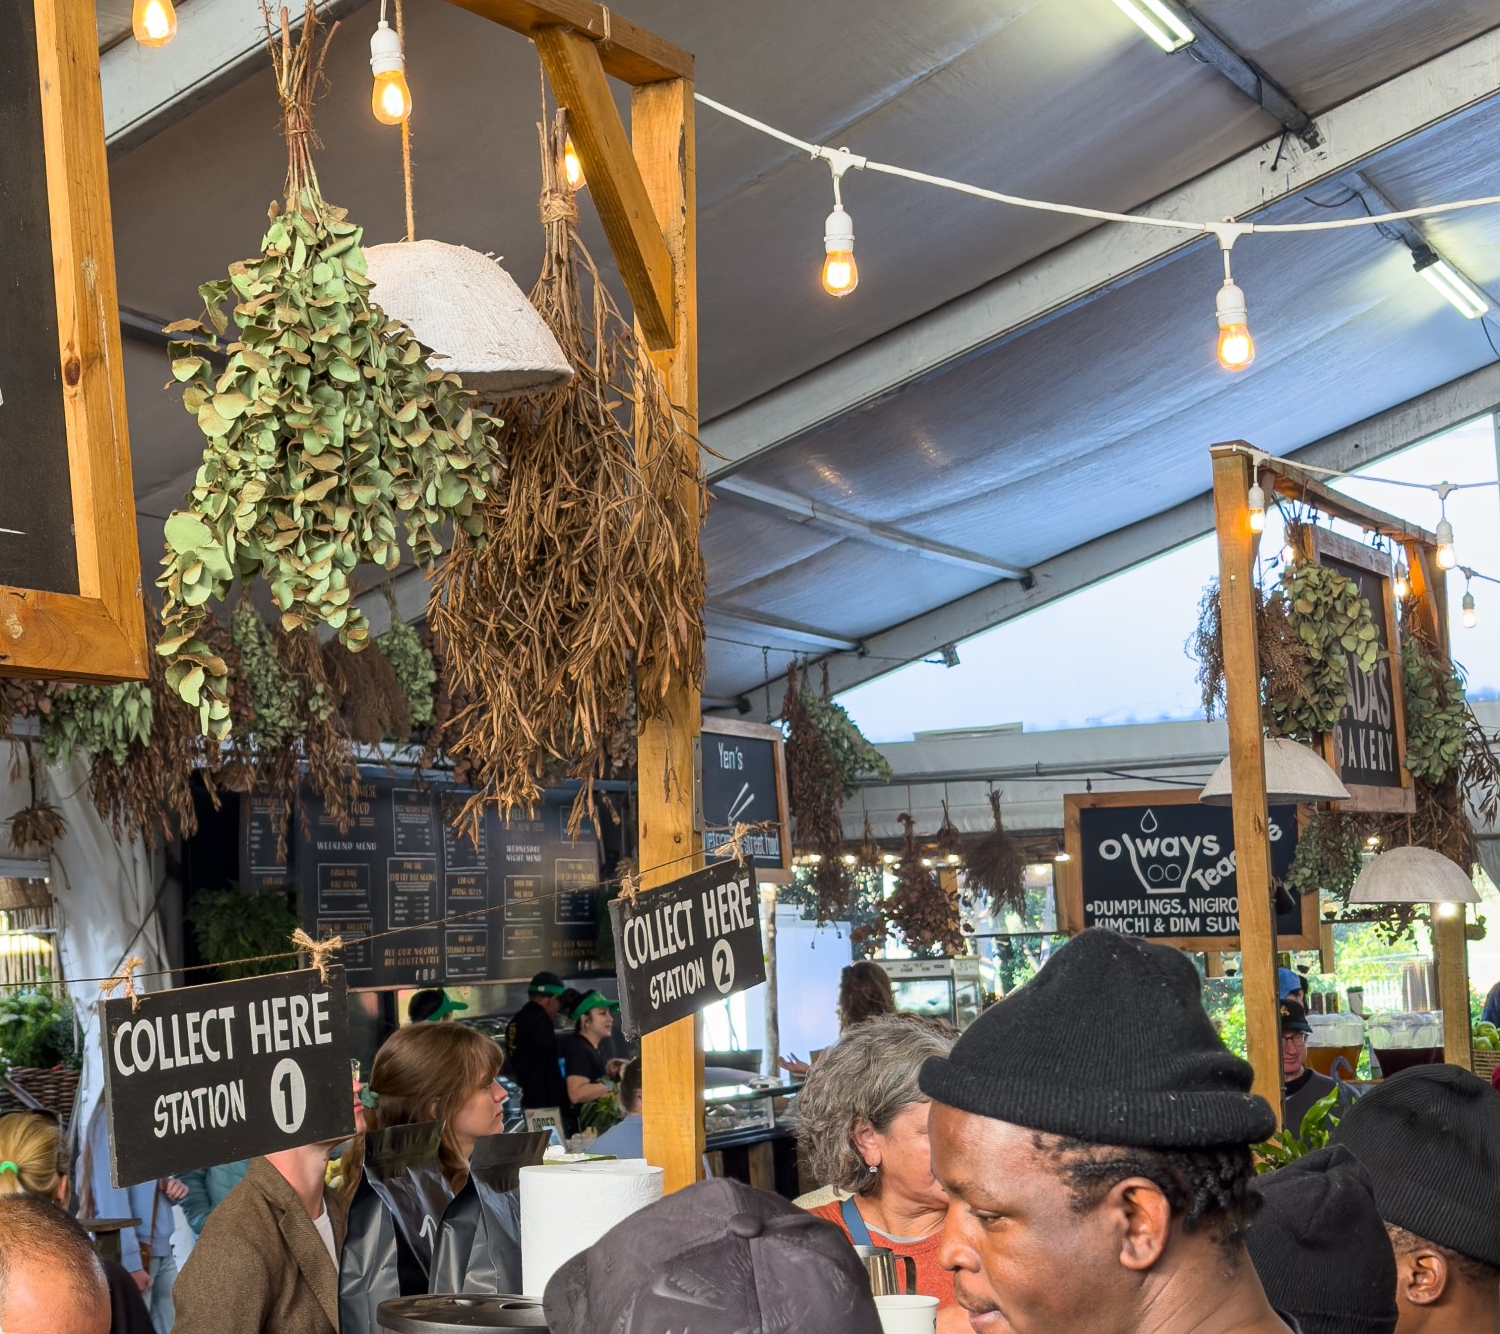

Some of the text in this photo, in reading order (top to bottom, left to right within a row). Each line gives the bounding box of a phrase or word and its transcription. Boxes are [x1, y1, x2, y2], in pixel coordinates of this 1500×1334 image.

[717, 741, 743, 771] Yen's
[1336, 724, 1394, 772] BAKERY
[316, 841, 377, 851] WEEKEND MENU
[624, 877, 755, 970] COLLECT HERE
[1153, 917, 1166, 933] &
[1170, 917, 1200, 933] DIM
[649, 941, 733, 1010] STATION 2
[113, 991, 333, 1077] COLLECT HERE
[152, 1061, 303, 1139] STATION 1
